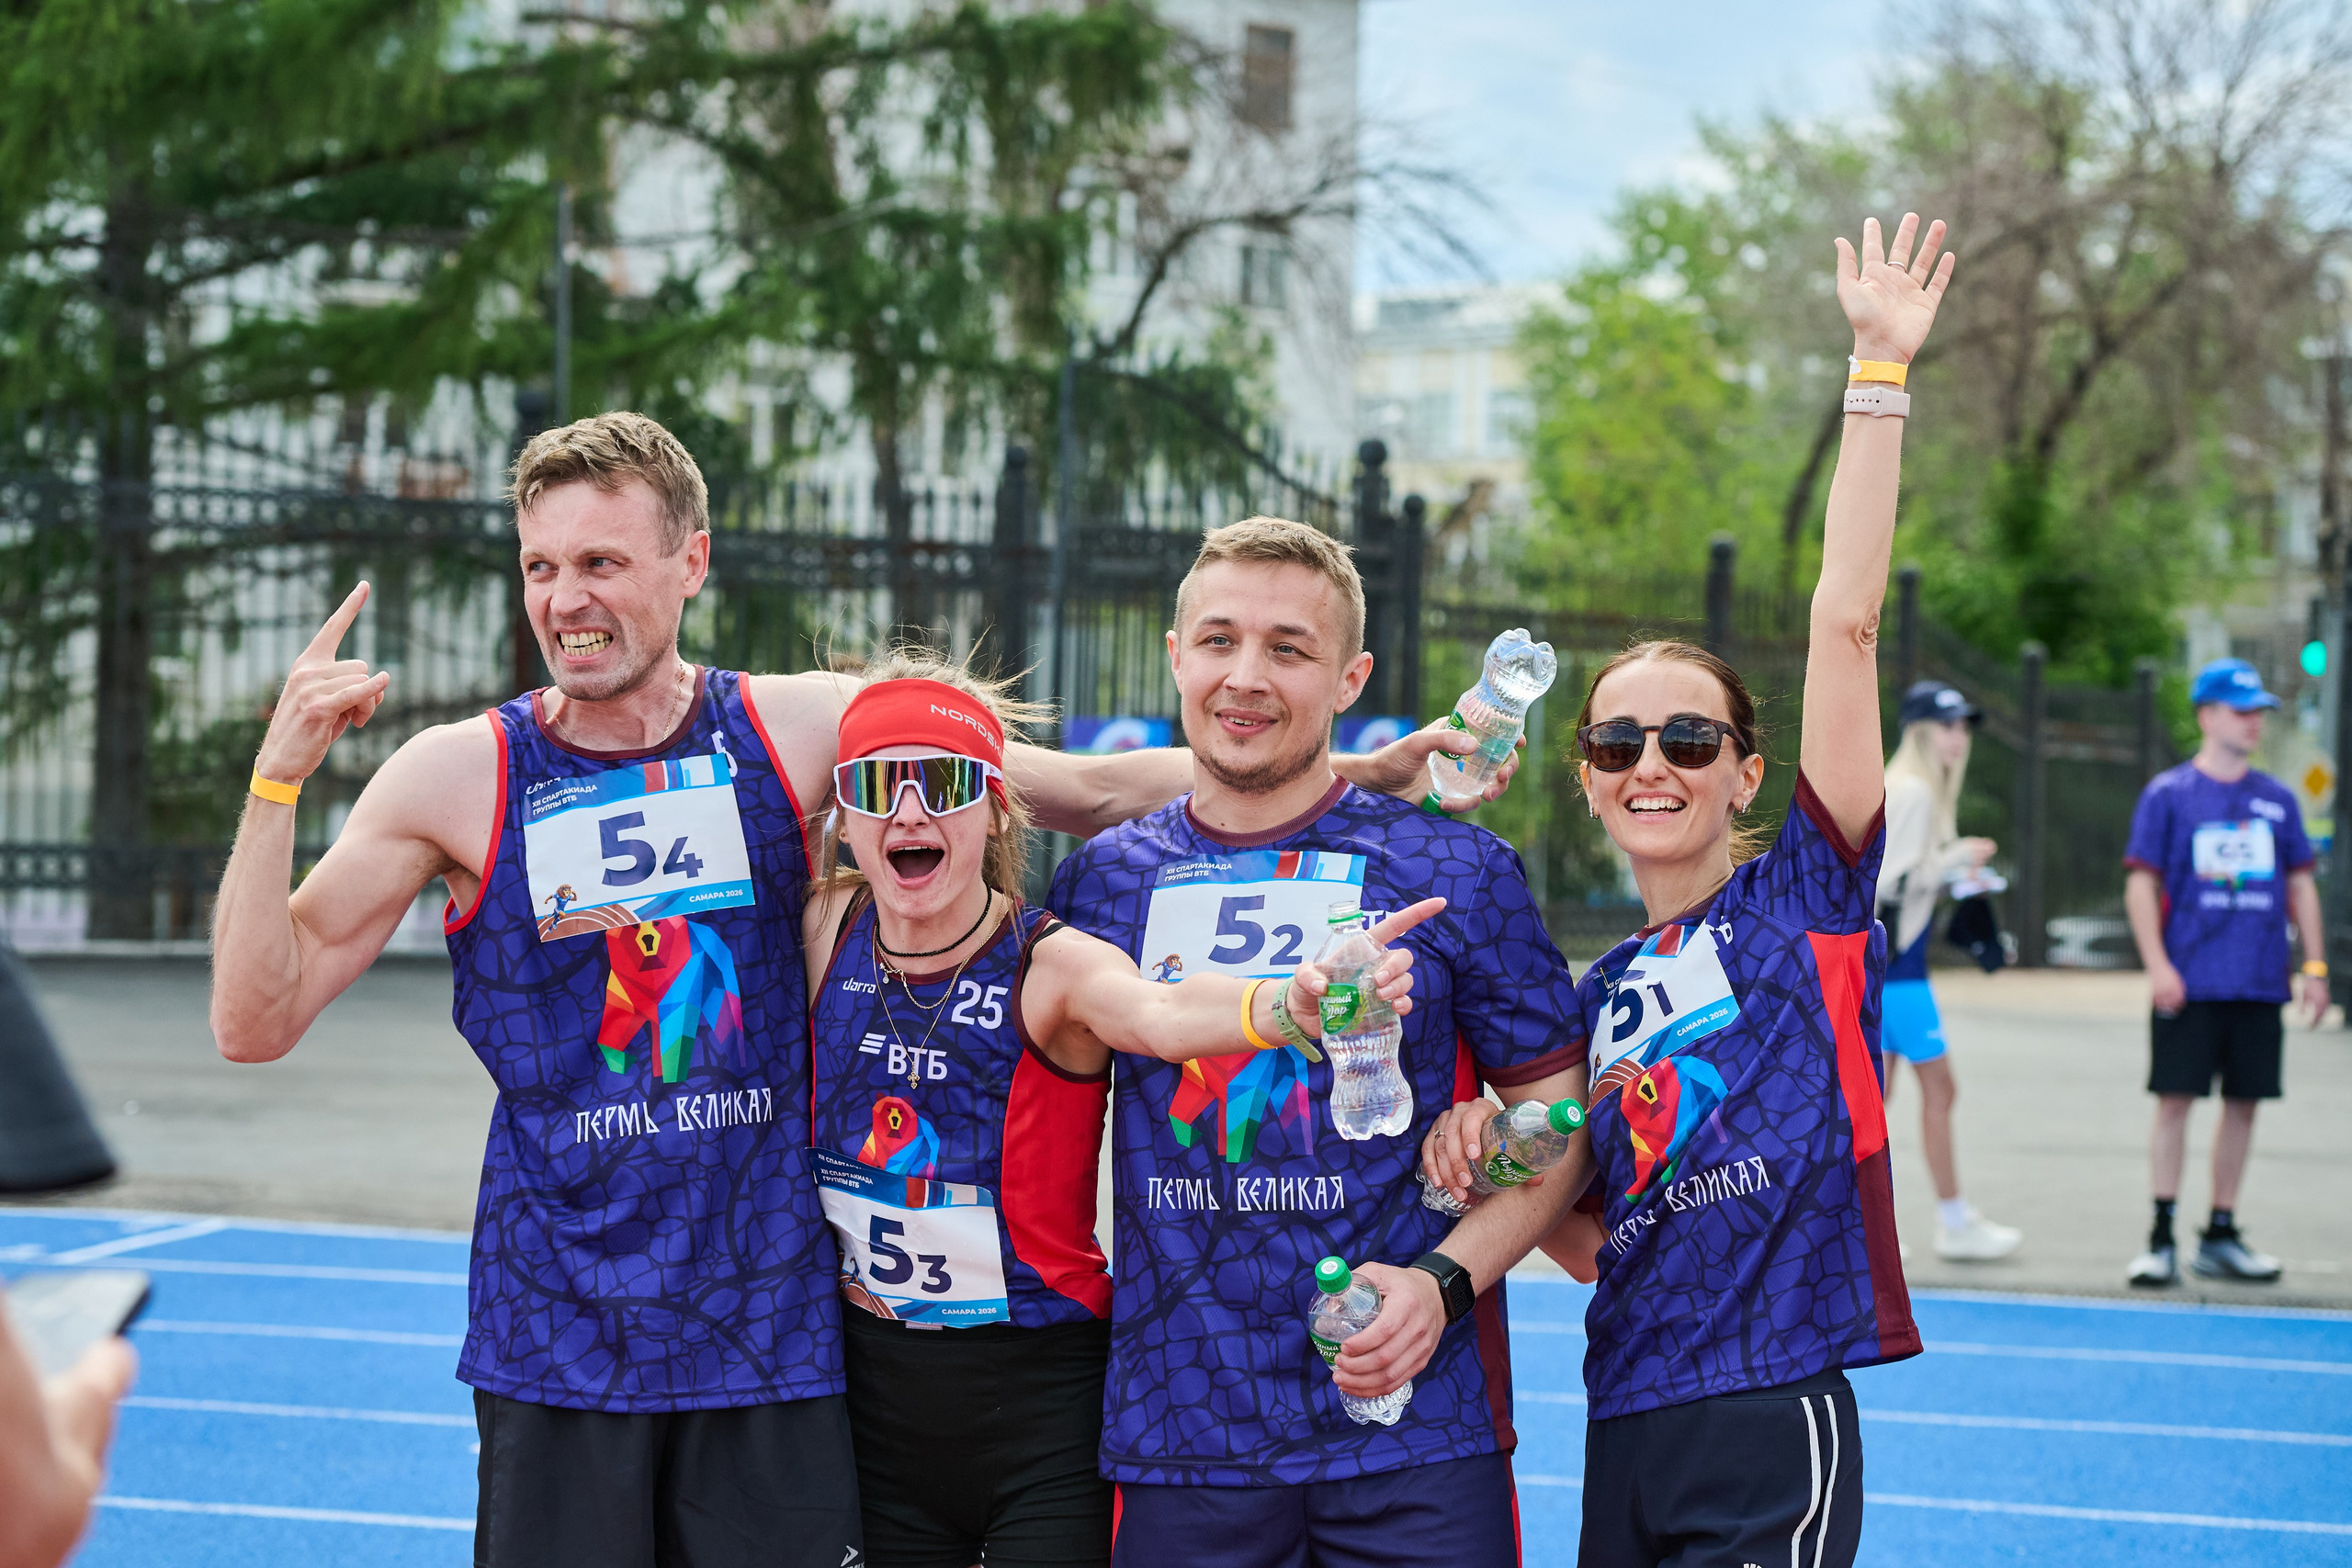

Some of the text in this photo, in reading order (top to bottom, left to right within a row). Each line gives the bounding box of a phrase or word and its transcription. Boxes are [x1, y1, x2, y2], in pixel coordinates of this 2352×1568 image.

[542, 784, 597, 803] СПАРТАКИАДА
[533, 795, 577, 816] ГРУППЫ ВТБ
[1165, 872, 1193, 882] ГРУППЫ
[1176, 863, 1232, 873] СПАРТАКИАДА
[689, 889, 743, 903] САМАРА 2026
[951, 980, 1009, 1030] 25
[1677, 1008, 1729, 1037] САМАРА 2026
[888, 1043, 948, 1080] ВТБ
[576, 1087, 773, 1143] ПЕРМЬ ВЕЛИКАЯ
[822, 1175, 860, 1189] ГРУППЫ ВТБ
[829, 1169, 874, 1185] СПАРТАКИАДА
[1665, 1156, 1770, 1213] ВЕЛИКАЯ
[1148, 1176, 1345, 1212] ПЕРМЬ ВЕЛИКАЯ
